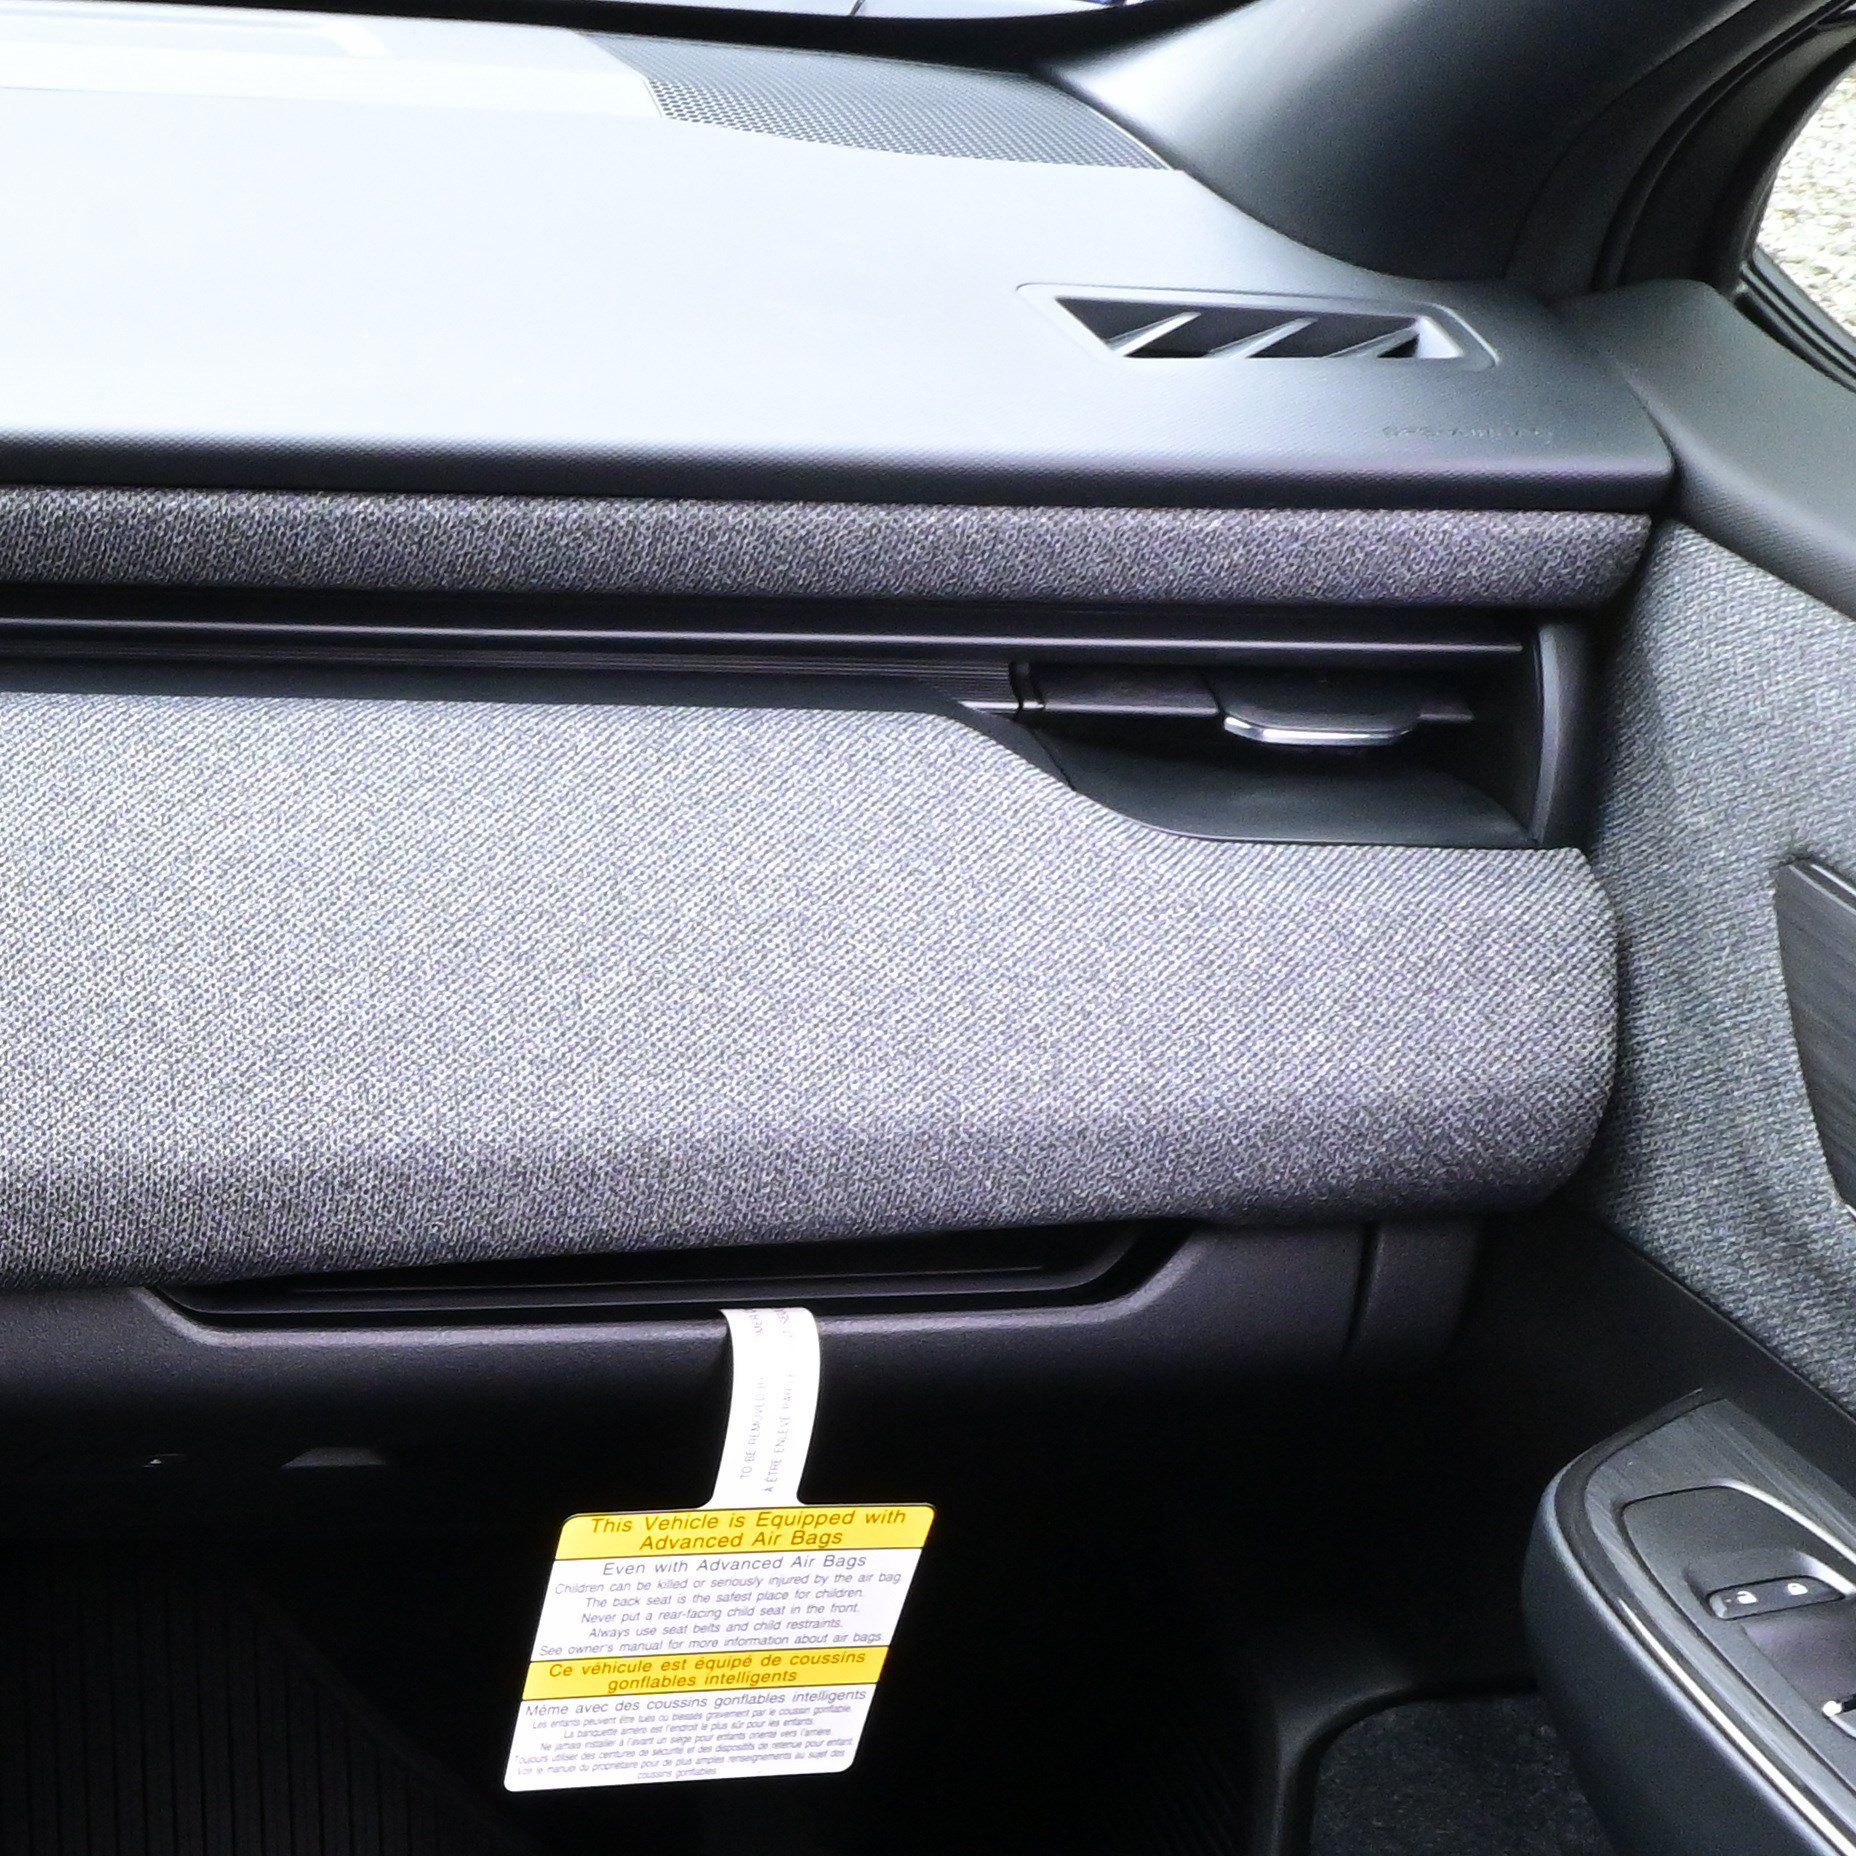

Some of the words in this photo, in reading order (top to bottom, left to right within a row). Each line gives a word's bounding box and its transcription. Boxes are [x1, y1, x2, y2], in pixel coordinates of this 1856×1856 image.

[591, 1518, 632, 1532] This
[645, 1513, 718, 1530] Vehicle
[728, 1512, 745, 1528] is
[755, 1509, 855, 1529] Equipped
[865, 1509, 905, 1523] with
[638, 1532, 743, 1550] Advanced
[750, 1530, 781, 1546] Air
[790, 1529, 842, 1548] Bags
[602, 1561, 645, 1575] Even
[654, 1559, 688, 1573] with
[695, 1555, 784, 1571] Advanced
[789, 1554, 816, 1568] Air
[822, 1553, 866, 1570] Bags
[549, 1663, 572, 1677] Ce
[581, 1659, 652, 1675] véhicule
[660, 1658, 686, 1671] est
[694, 1654, 752, 1671] équipé
[760, 1654, 781, 1666] de
[789, 1650, 865, 1665] coussins
[607, 1674, 696, 1693] gonflables
[704, 1670, 797, 1686] intelligents
[574, 1703, 609, 1714] avec
[614, 1700, 640, 1711] des
[646, 1696, 707, 1710] coussins
[713, 1691, 785, 1709] gonflables
[791, 1689, 866, 1704] intelligents
